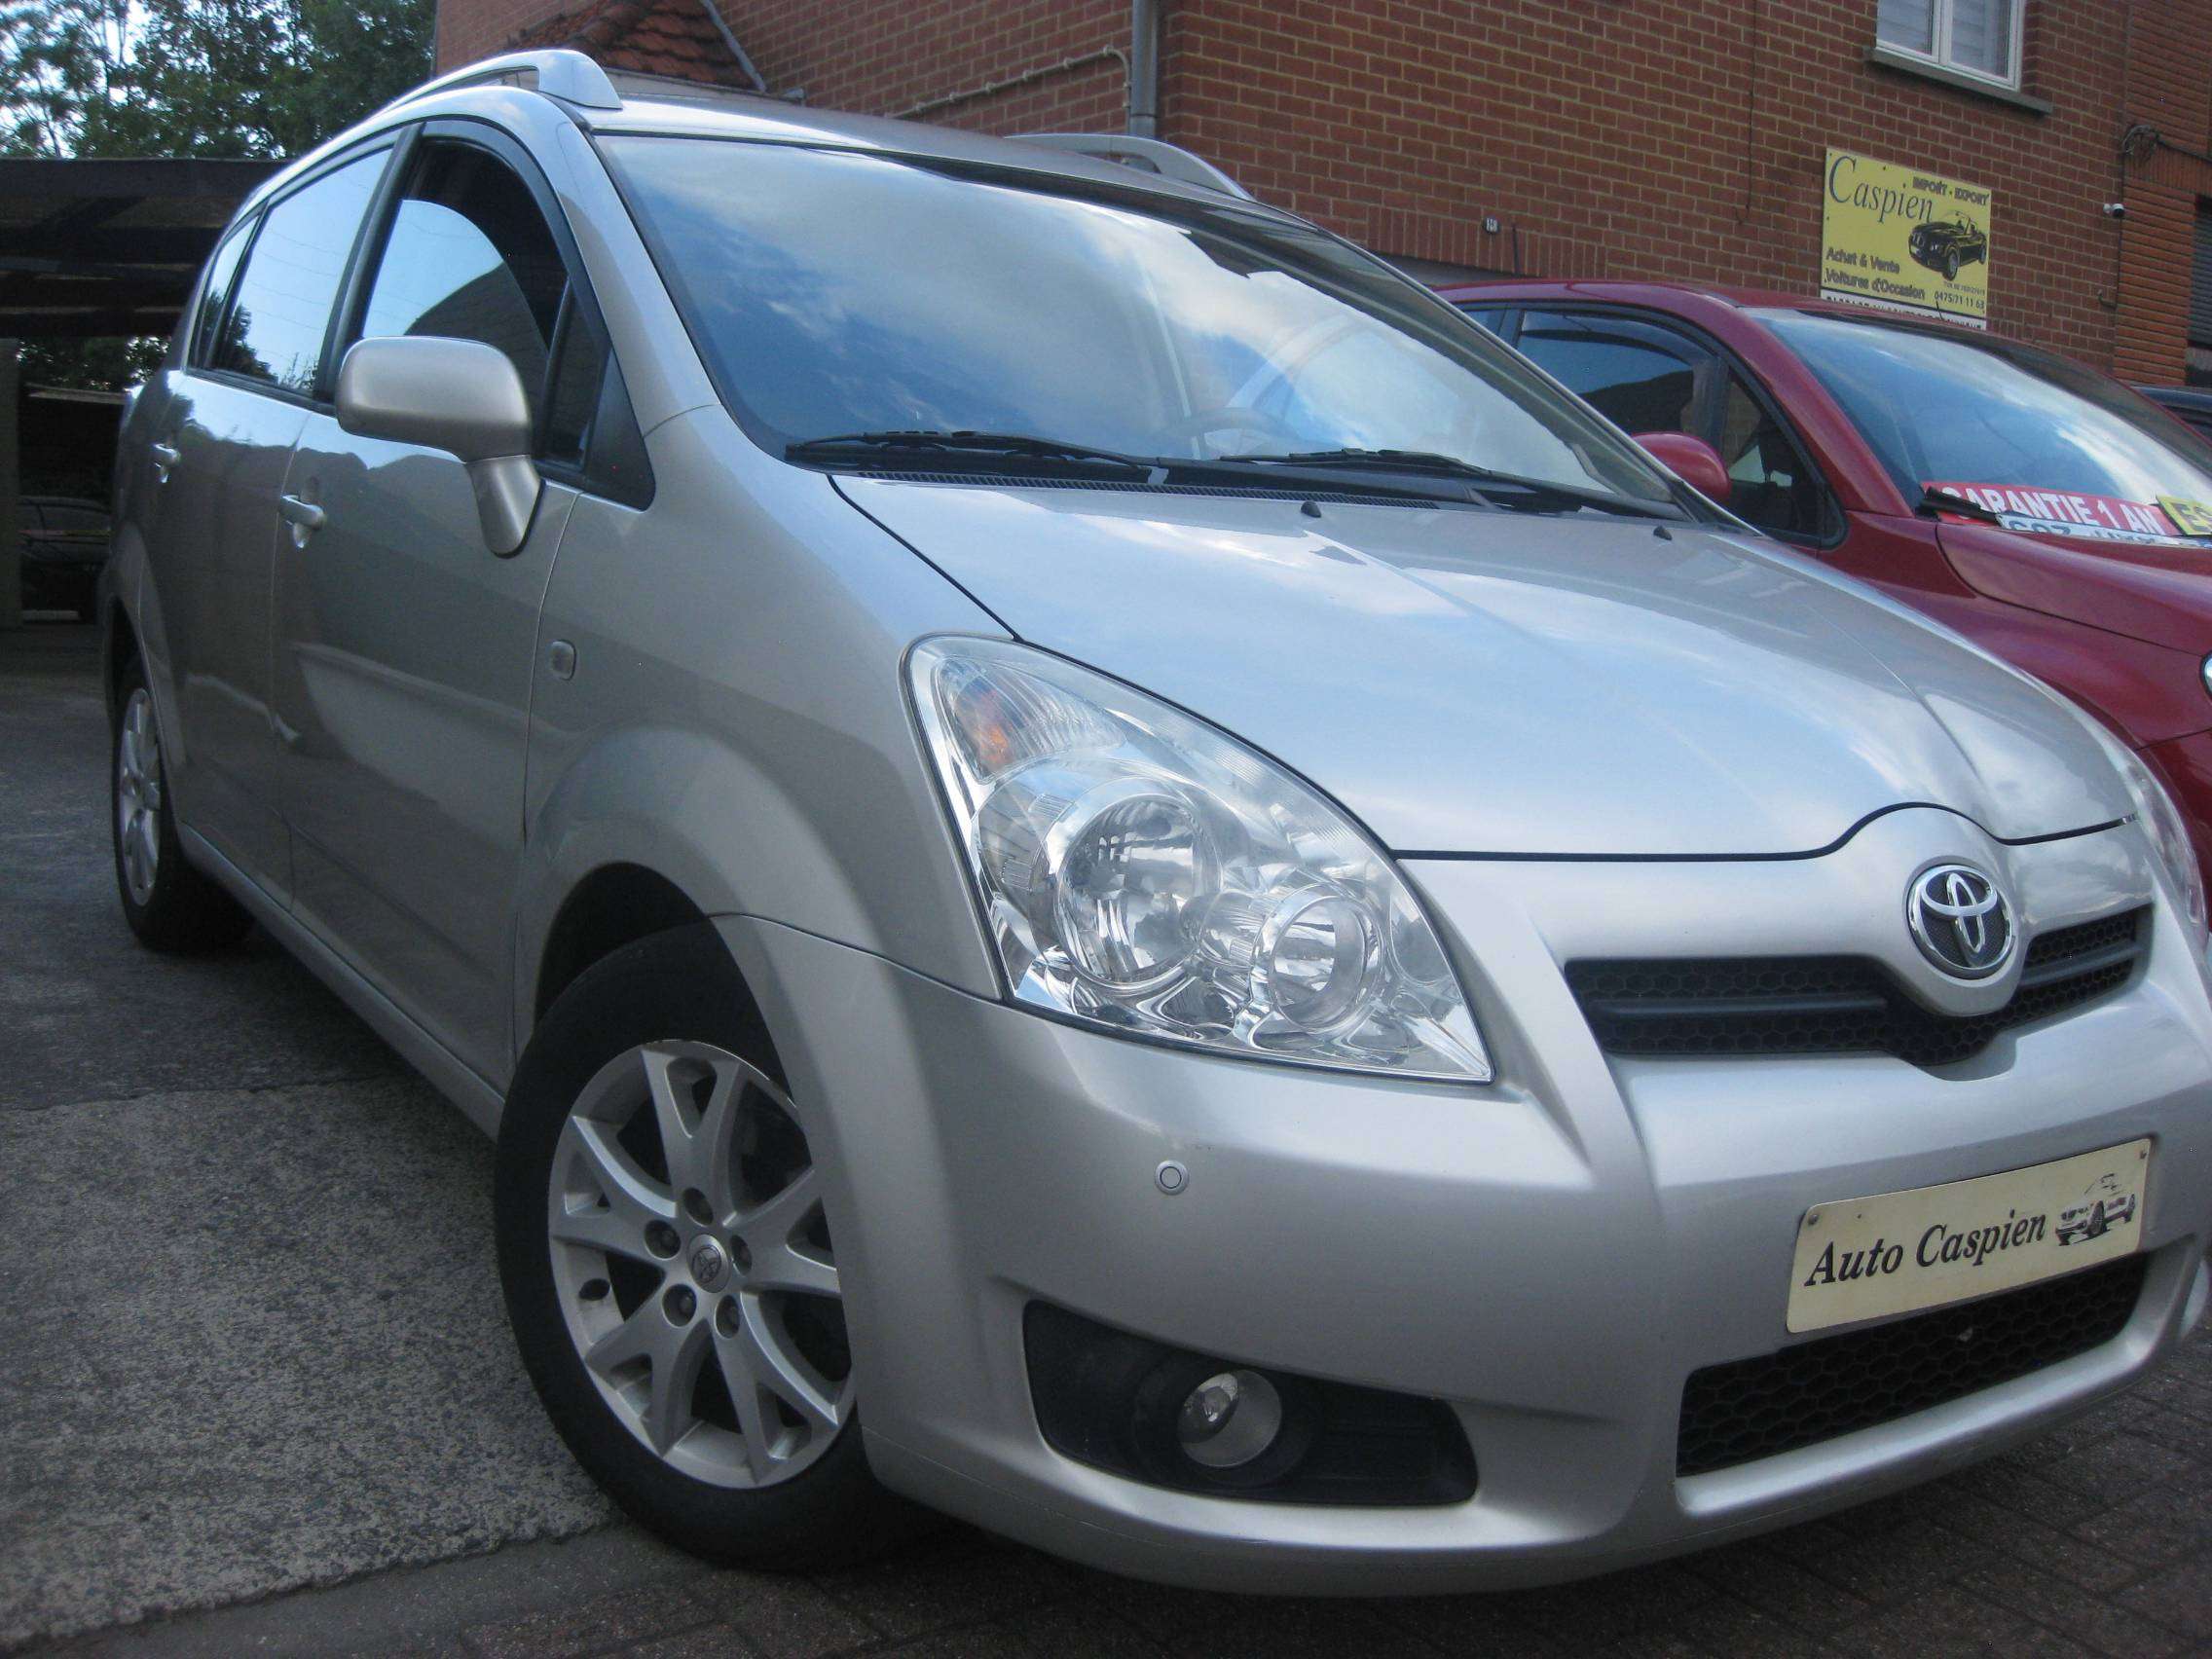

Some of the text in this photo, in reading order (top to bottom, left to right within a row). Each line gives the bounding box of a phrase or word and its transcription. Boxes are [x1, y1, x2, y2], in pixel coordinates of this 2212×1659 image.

[1828, 155, 1933, 224] Caspien
[2097, 498, 2121, 529] 1
[2120, 504, 2167, 535] AN
[1803, 1207, 2047, 1287] Auto Caspien
